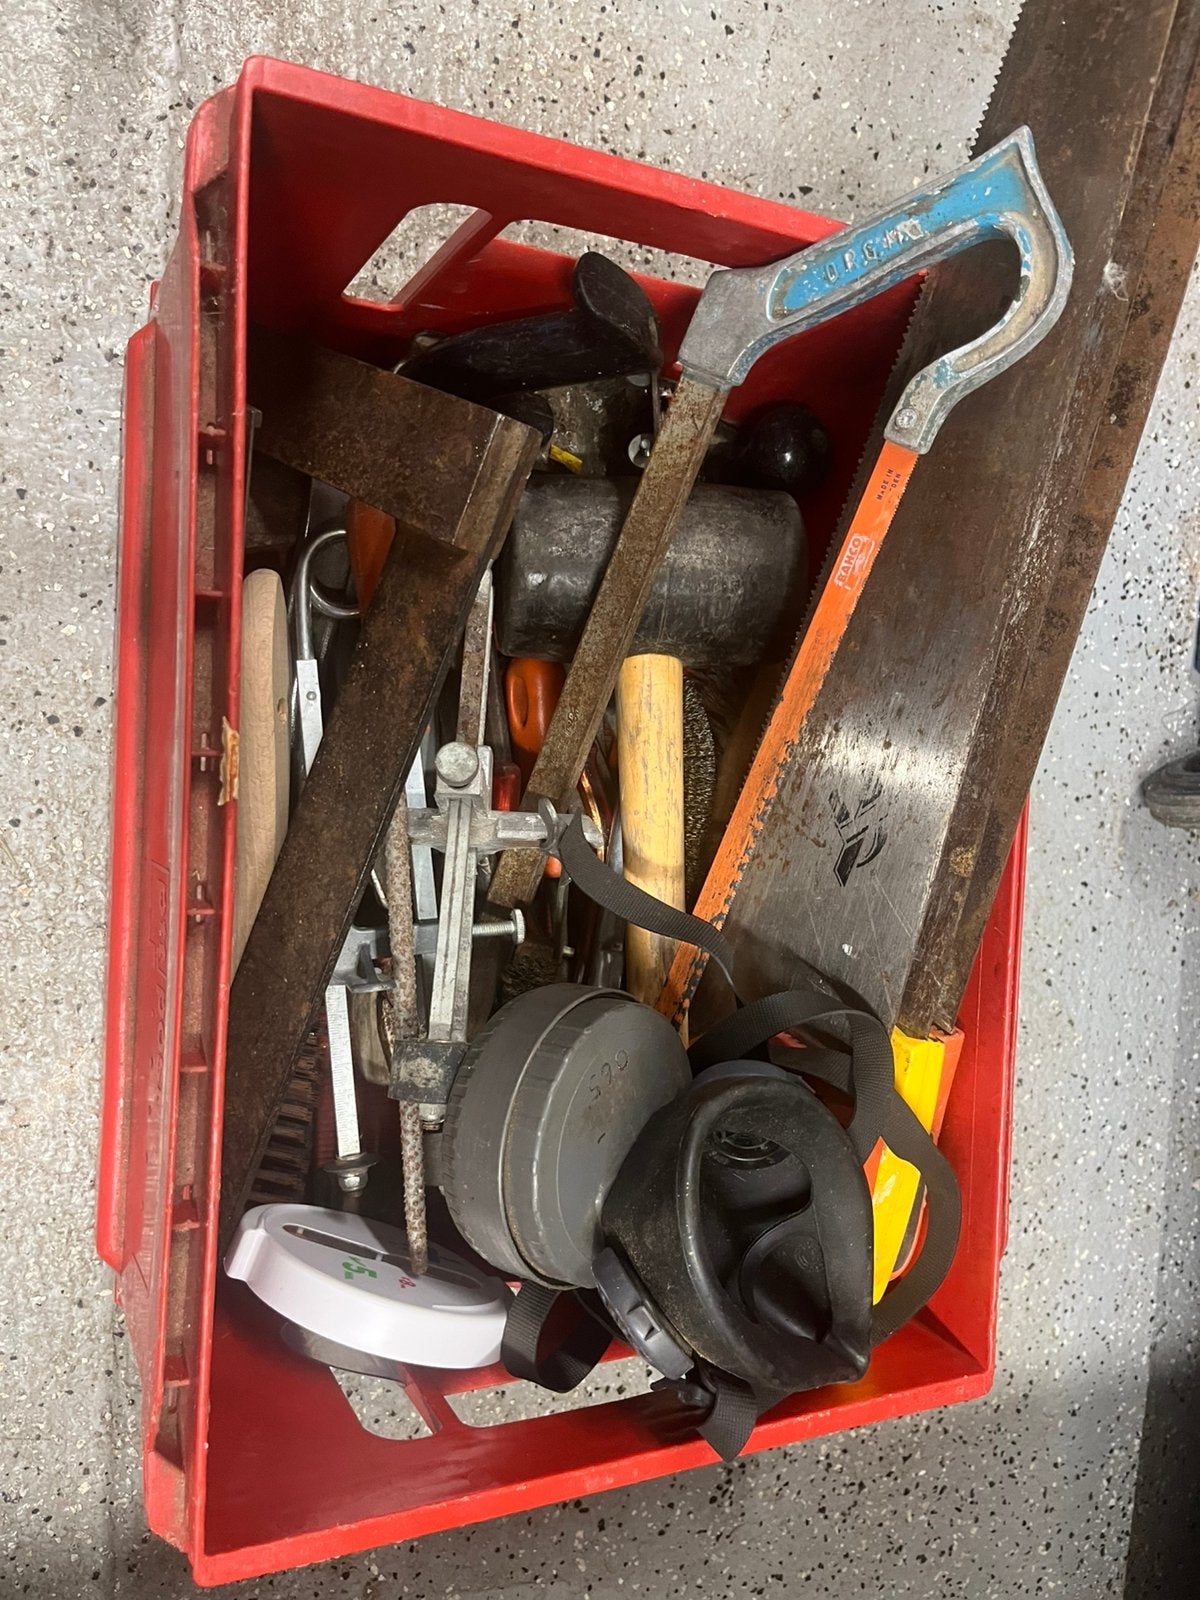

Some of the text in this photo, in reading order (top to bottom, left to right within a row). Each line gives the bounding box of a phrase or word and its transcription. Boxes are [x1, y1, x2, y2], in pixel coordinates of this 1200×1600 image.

[877, 468, 894, 501] MADE IN
[837, 537, 862, 583] BAHCO
